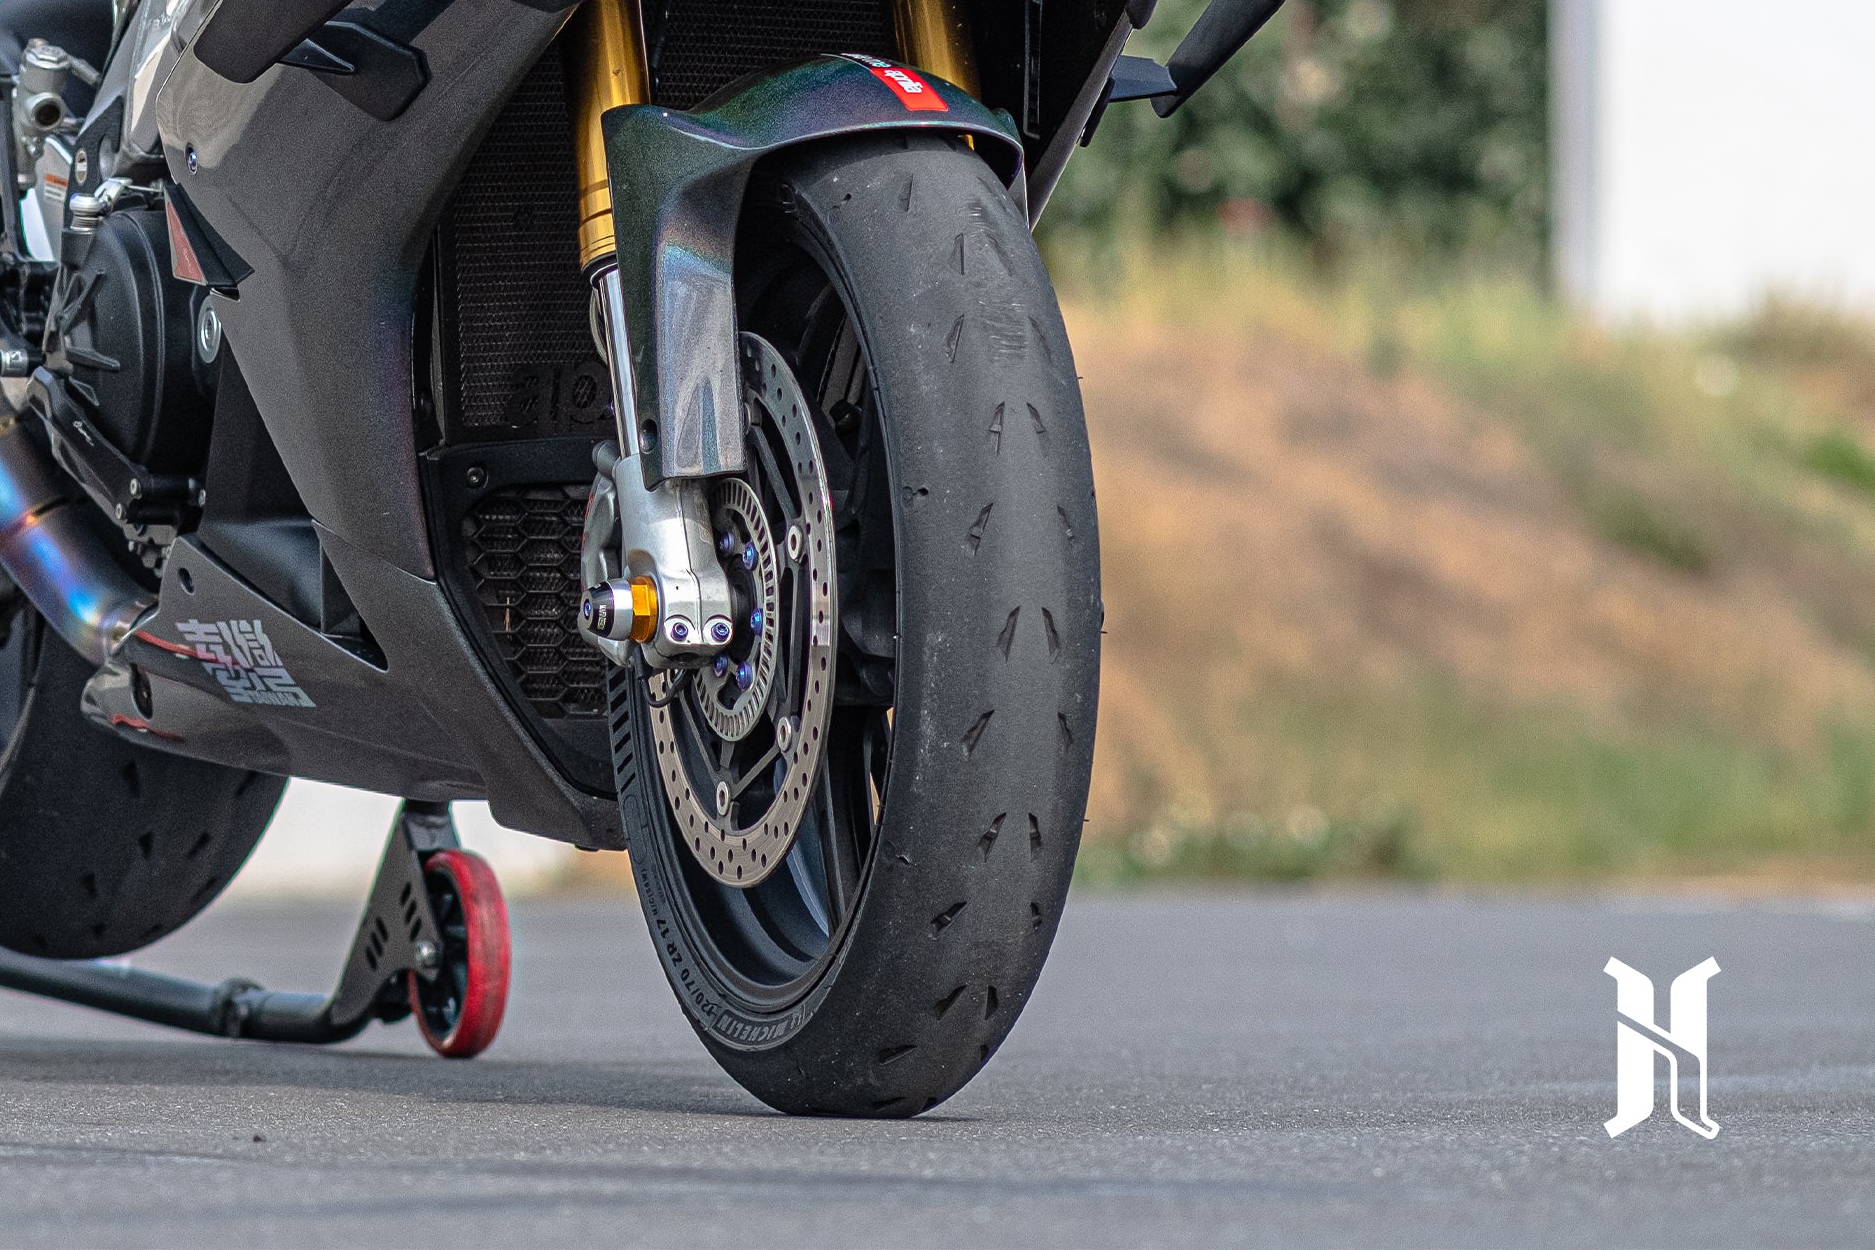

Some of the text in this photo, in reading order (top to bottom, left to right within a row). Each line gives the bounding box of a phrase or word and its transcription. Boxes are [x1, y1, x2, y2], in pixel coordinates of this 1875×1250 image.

[656, 918, 670, 939] 17
[666, 941, 683, 968] ZR
[717, 1012, 788, 1043] MICHELIN
